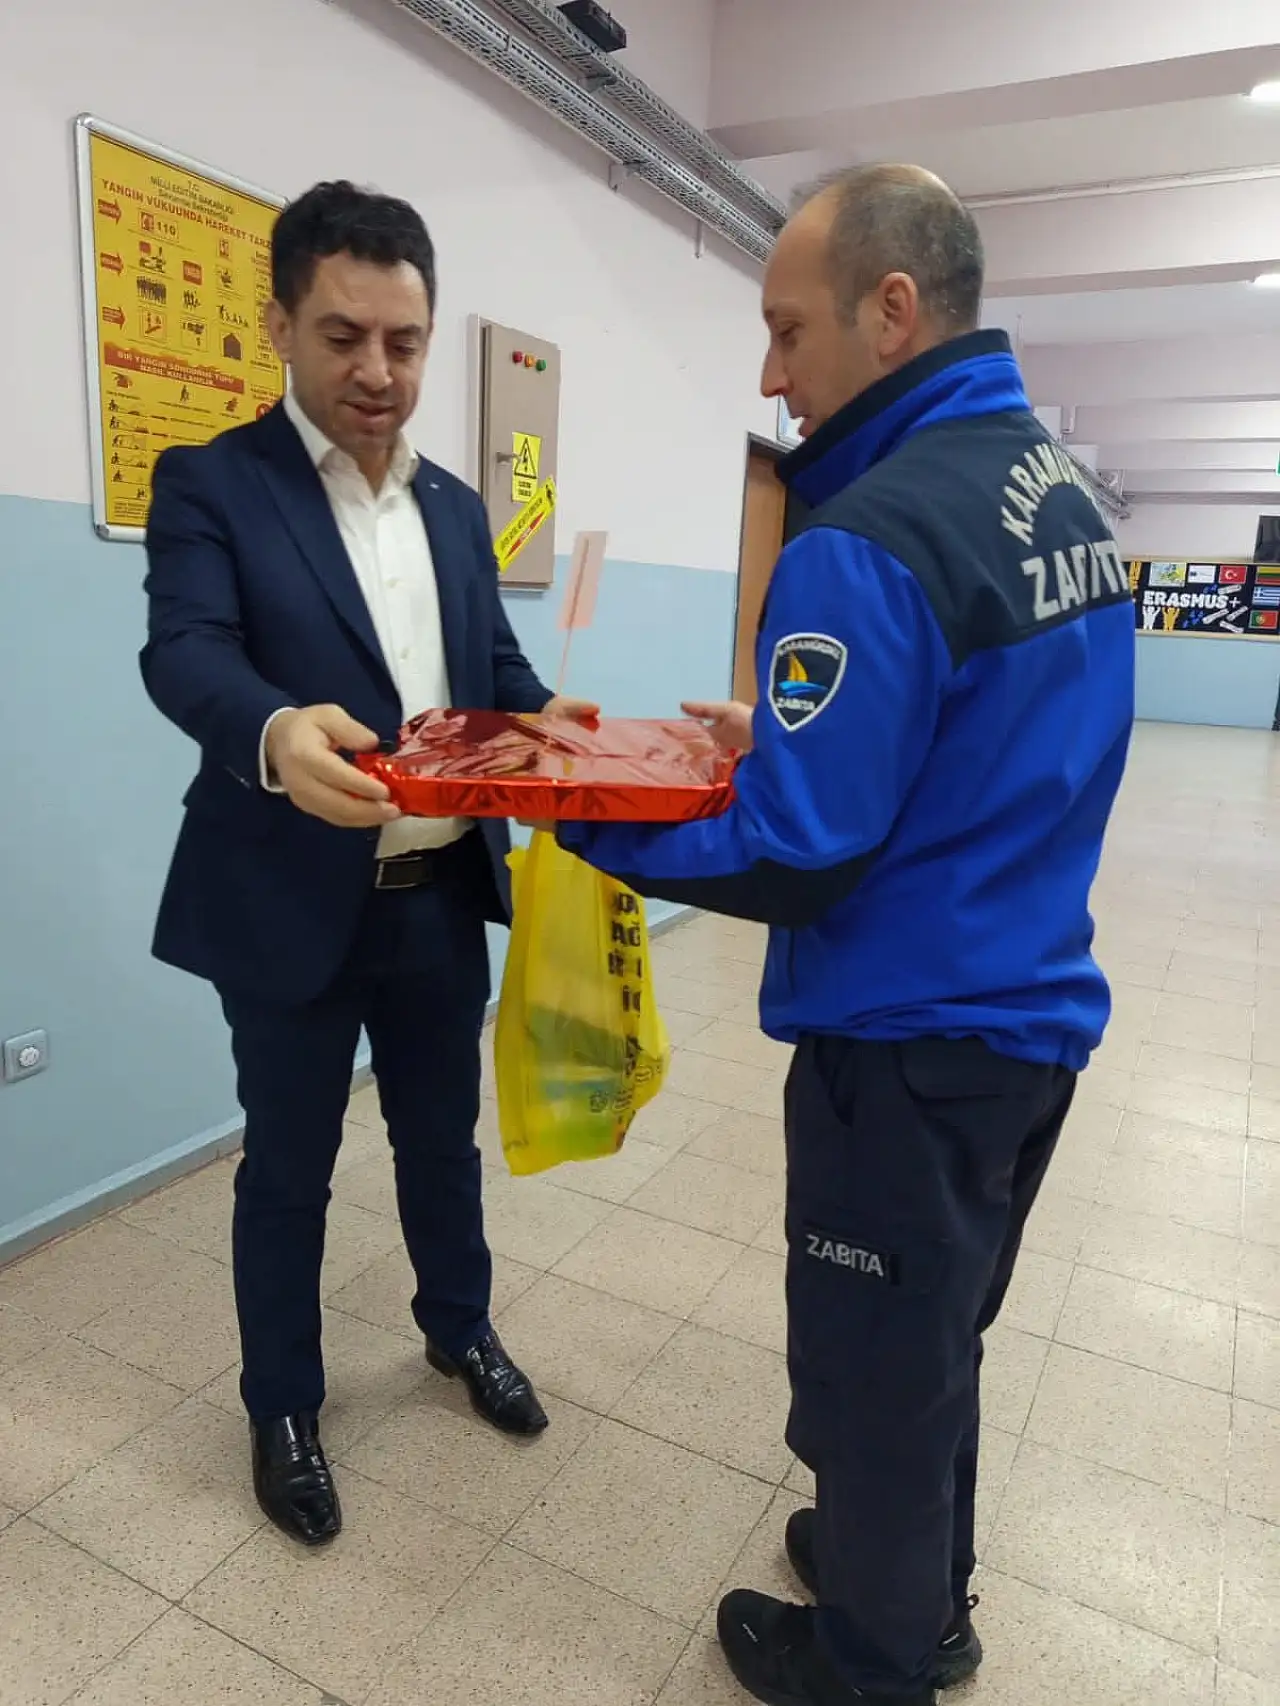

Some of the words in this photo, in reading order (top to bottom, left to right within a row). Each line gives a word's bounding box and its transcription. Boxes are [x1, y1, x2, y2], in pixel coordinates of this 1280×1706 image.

[102, 178, 144, 203] YANGIN
[146, 194, 203, 224] VUKUUNDA
[205, 217, 247, 241] HAREKET
[806, 1233, 884, 1277] ZABITA
